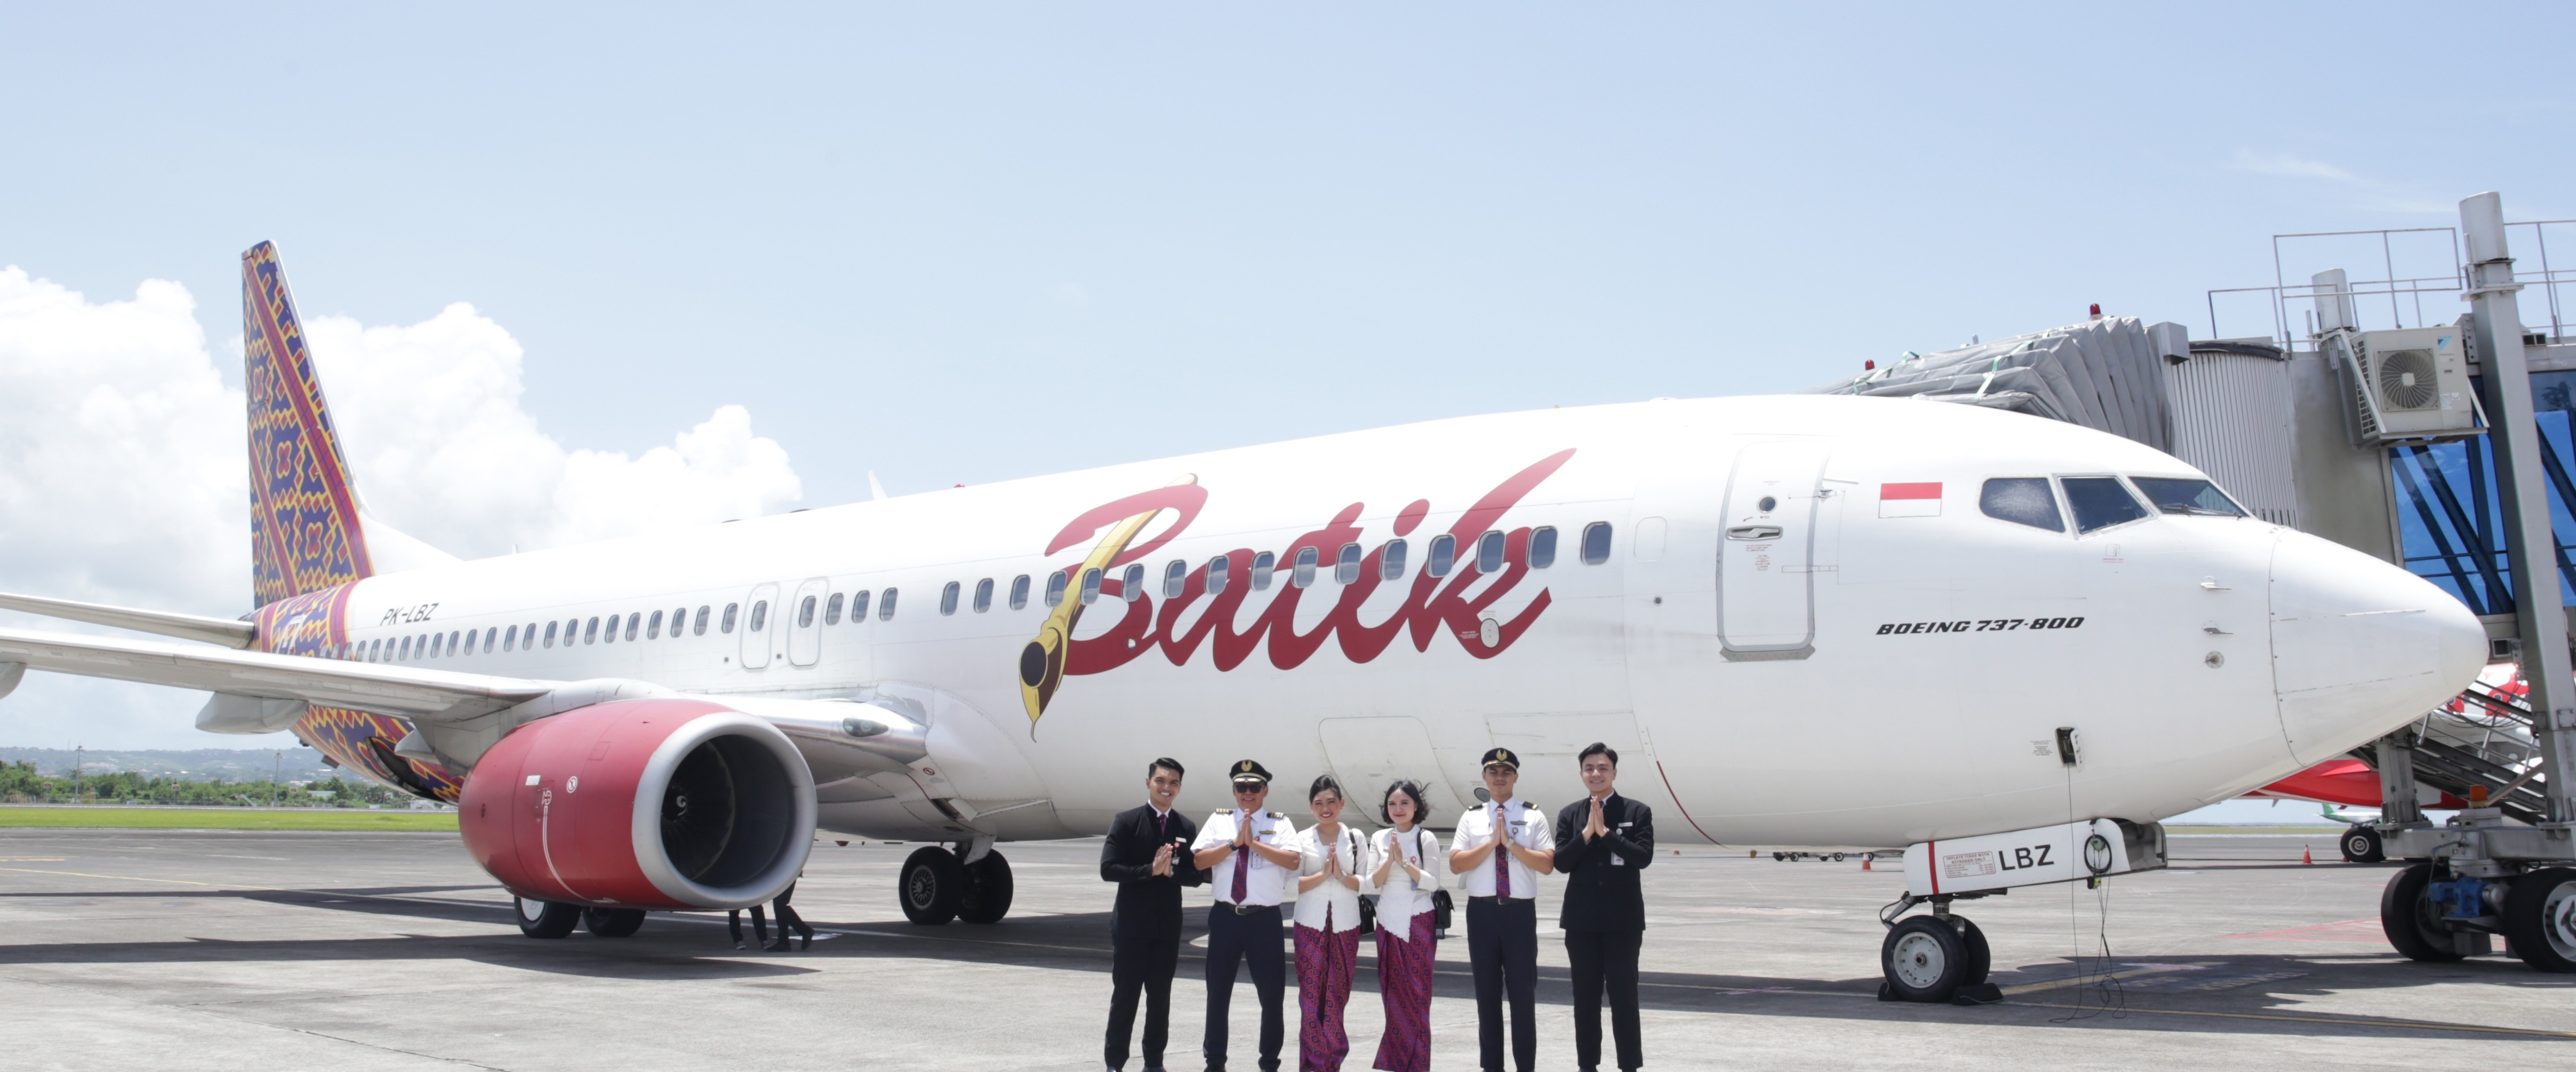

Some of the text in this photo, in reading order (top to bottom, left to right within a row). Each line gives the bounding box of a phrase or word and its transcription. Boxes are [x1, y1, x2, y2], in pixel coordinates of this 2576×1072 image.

[1044, 447, 1577, 676] Batik
[379, 602, 439, 626] PK-LBZ
[1875, 617, 2085, 635] BOEING 737-800
[1998, 844, 2054, 871] LBZ
